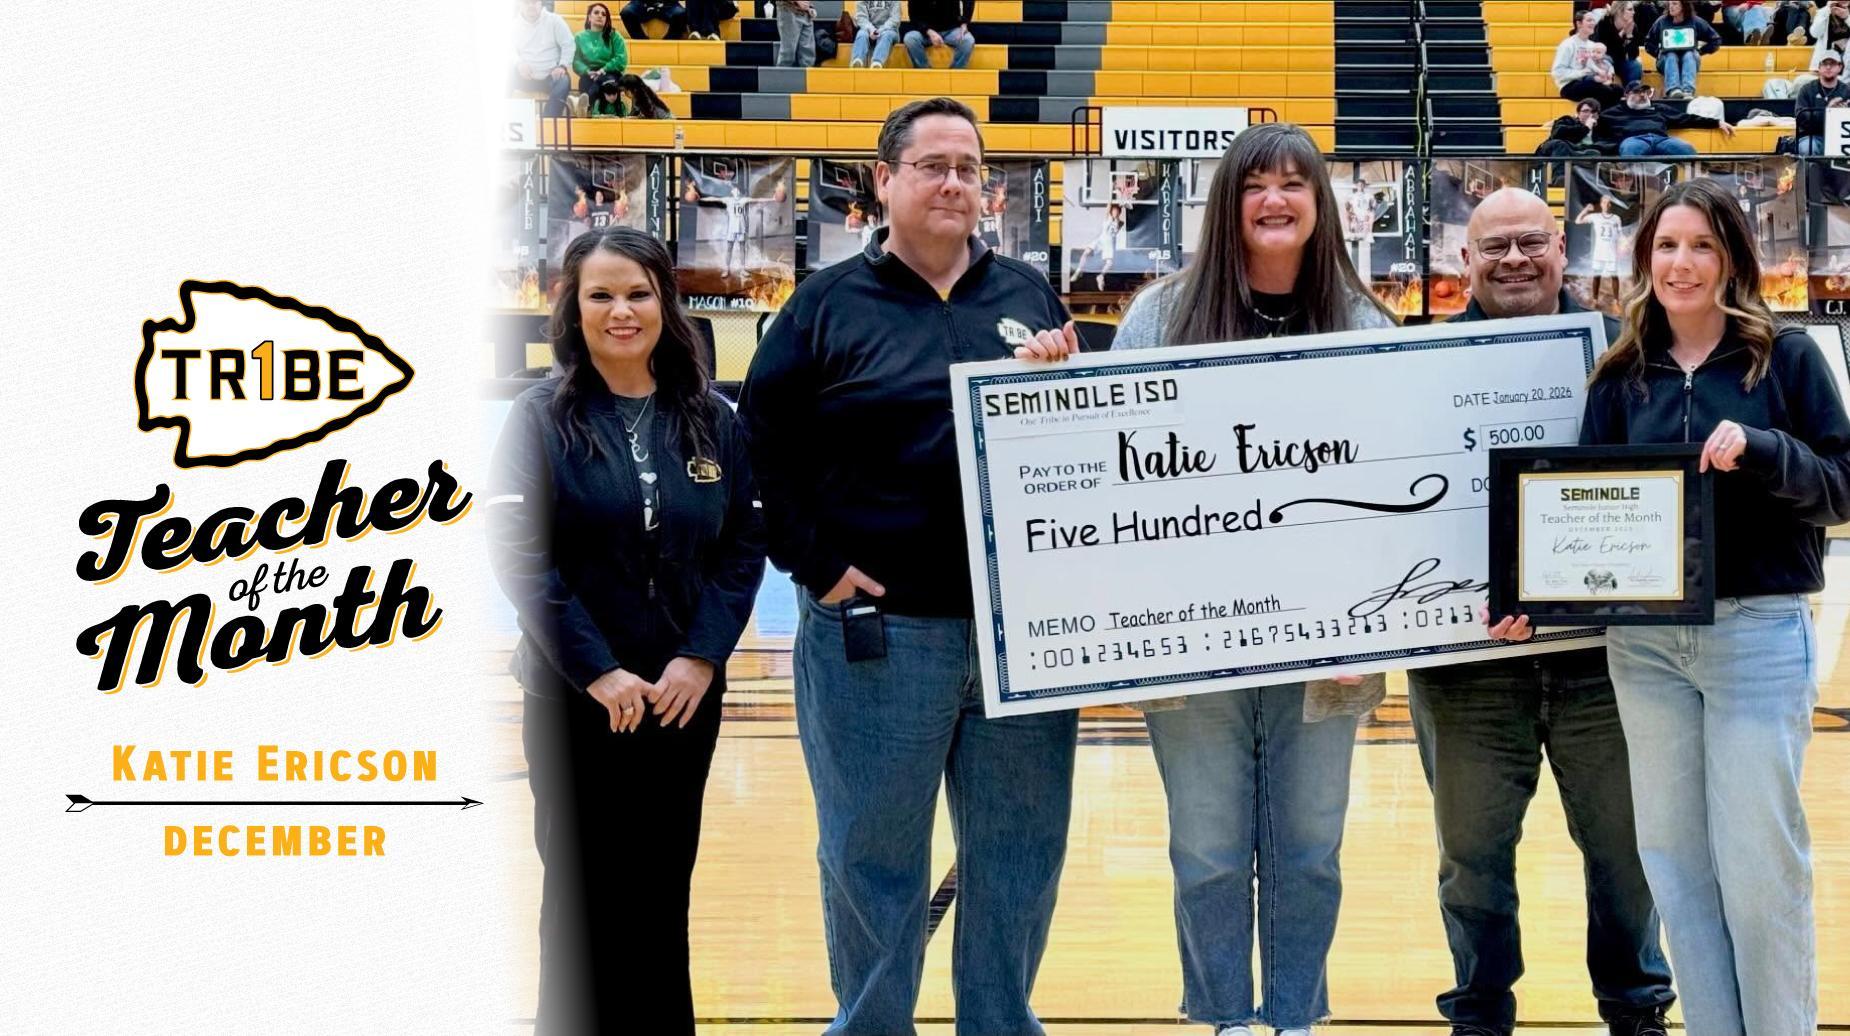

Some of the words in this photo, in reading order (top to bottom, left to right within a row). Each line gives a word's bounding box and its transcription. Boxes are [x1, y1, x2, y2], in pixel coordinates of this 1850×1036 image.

[1114, 130, 1235, 150] VISITORS
[1033, 168, 1044, 222] ADDI
[1022, 251, 1048, 261] #20
[987, 384, 1126, 418] SEMINOLE
[1135, 378, 1179, 404] ISD
[1453, 393, 1491, 408] DATE
[1492, 391, 1529, 405] January
[1548, 386, 1573, 399] 2026
[1489, 424, 1545, 446] 500.00
[1118, 430, 1216, 482] Katie
[1233, 423, 1358, 474] Ericson
[1019, 465, 1051, 480] PAY
[1052, 463, 1075, 477] TO
[1079, 461, 1107, 474] THE
[1024, 480, 1077, 495] ORDER
[1080, 478, 1101, 490] OF
[1561, 487, 1640, 501] SEMINOLE
[1026, 518, 1100, 552] Five
[1112, 499, 1262, 544] Hundred
[1540, 513, 1585, 524] Teacher
[1588, 512, 1600, 523] of
[1602, 512, 1621, 523] the
[1624, 511, 1662, 523] Month
[1552, 536, 1592, 555] Katie
[1599, 536, 1652, 555] Ericson
[1028, 615, 1096, 638] MEMO
[1109, 608, 1174, 629] Teacher
[1178, 603, 1195, 622] of
[1201, 601, 1228, 619] the
[1232, 594, 1281, 615] Month
